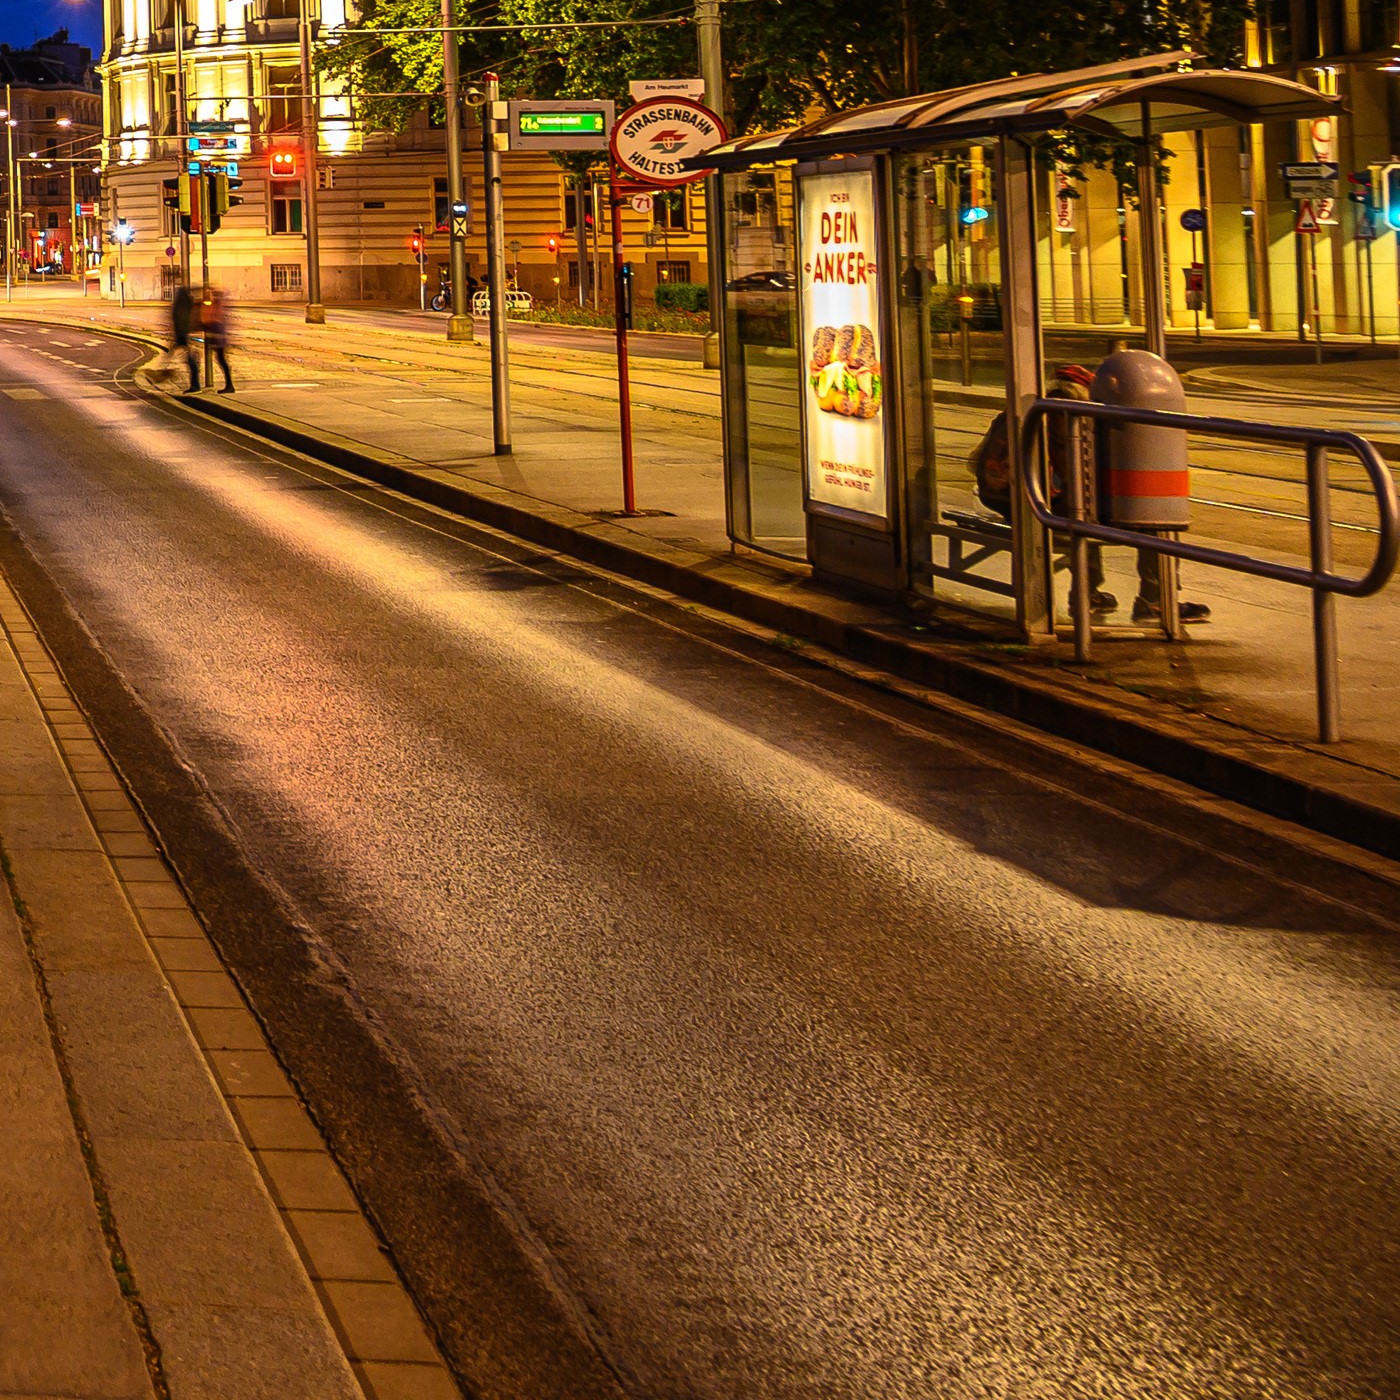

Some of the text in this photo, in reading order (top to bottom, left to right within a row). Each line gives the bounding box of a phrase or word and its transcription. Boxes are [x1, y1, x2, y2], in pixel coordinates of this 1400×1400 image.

[623, 108, 714, 138] STRASSENBAHN
[628, 151, 684, 175] HALTEST
[635, 197, 650, 209] 71
[821, 211, 858, 244] DEIN
[813, 251, 867, 285] ANKER
